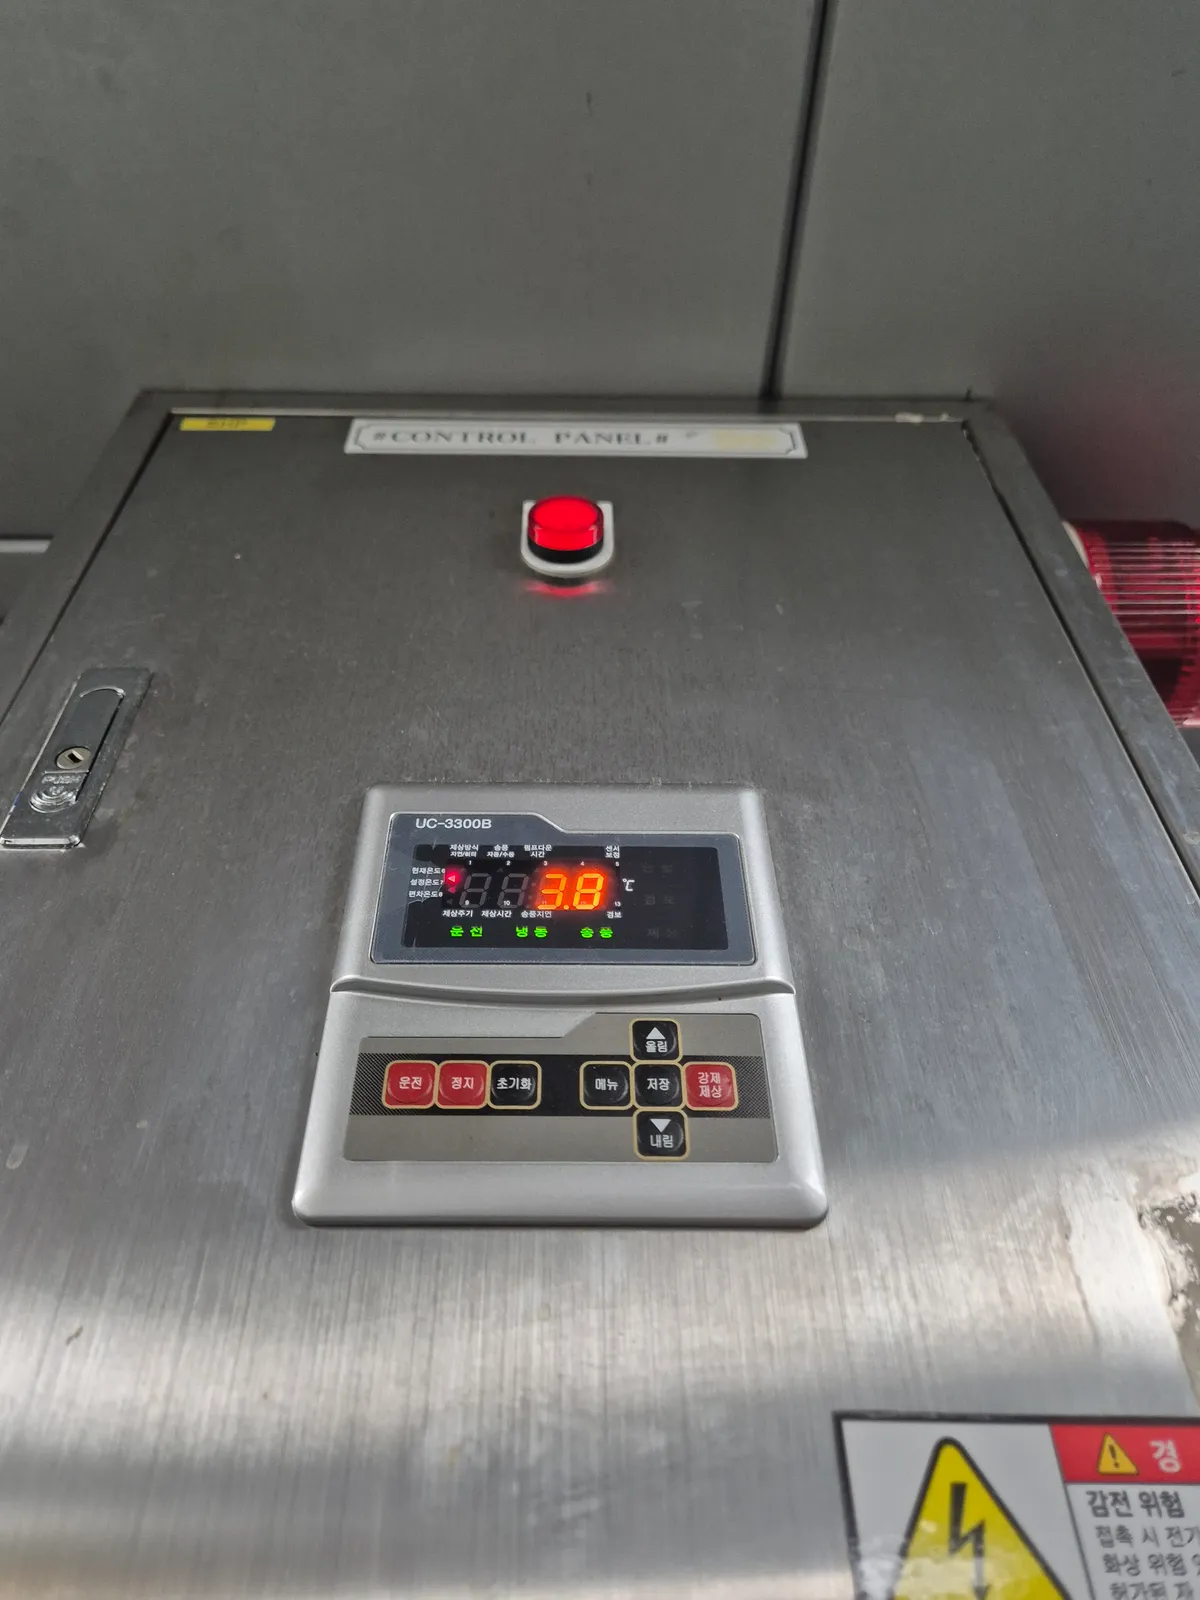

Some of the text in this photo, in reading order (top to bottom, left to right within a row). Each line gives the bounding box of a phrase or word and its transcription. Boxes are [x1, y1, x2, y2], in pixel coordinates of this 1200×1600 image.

[415, 817, 492, 829] UC-3300B
[537, 873, 604, 910] 3.8
[442, 910, 473, 918] 제상주기
[481, 910, 512, 918] 제상시간
[606, 911, 622, 919] 경보
[645, 1040, 668, 1053] 올림
[399, 1076, 423, 1090] 운전
[451, 1076, 474, 1090] 정지
[496, 1077, 532, 1091] 초기화
[594, 1078, 619, 1091] 메뉴
[646, 1078, 670, 1091] 저장
[697, 1071, 721, 1085] 강제
[698, 1085, 722, 1099] 제상
[650, 1134, 674, 1149] 내림
[1149, 1439, 1181, 1474] 경
[1086, 1490, 1185, 1519] 감전 위험
[1142, 1525, 1160, 1548] 시
[1103, 1553, 1142, 1577] 화상
[1148, 1552, 1188, 1577] 위험
